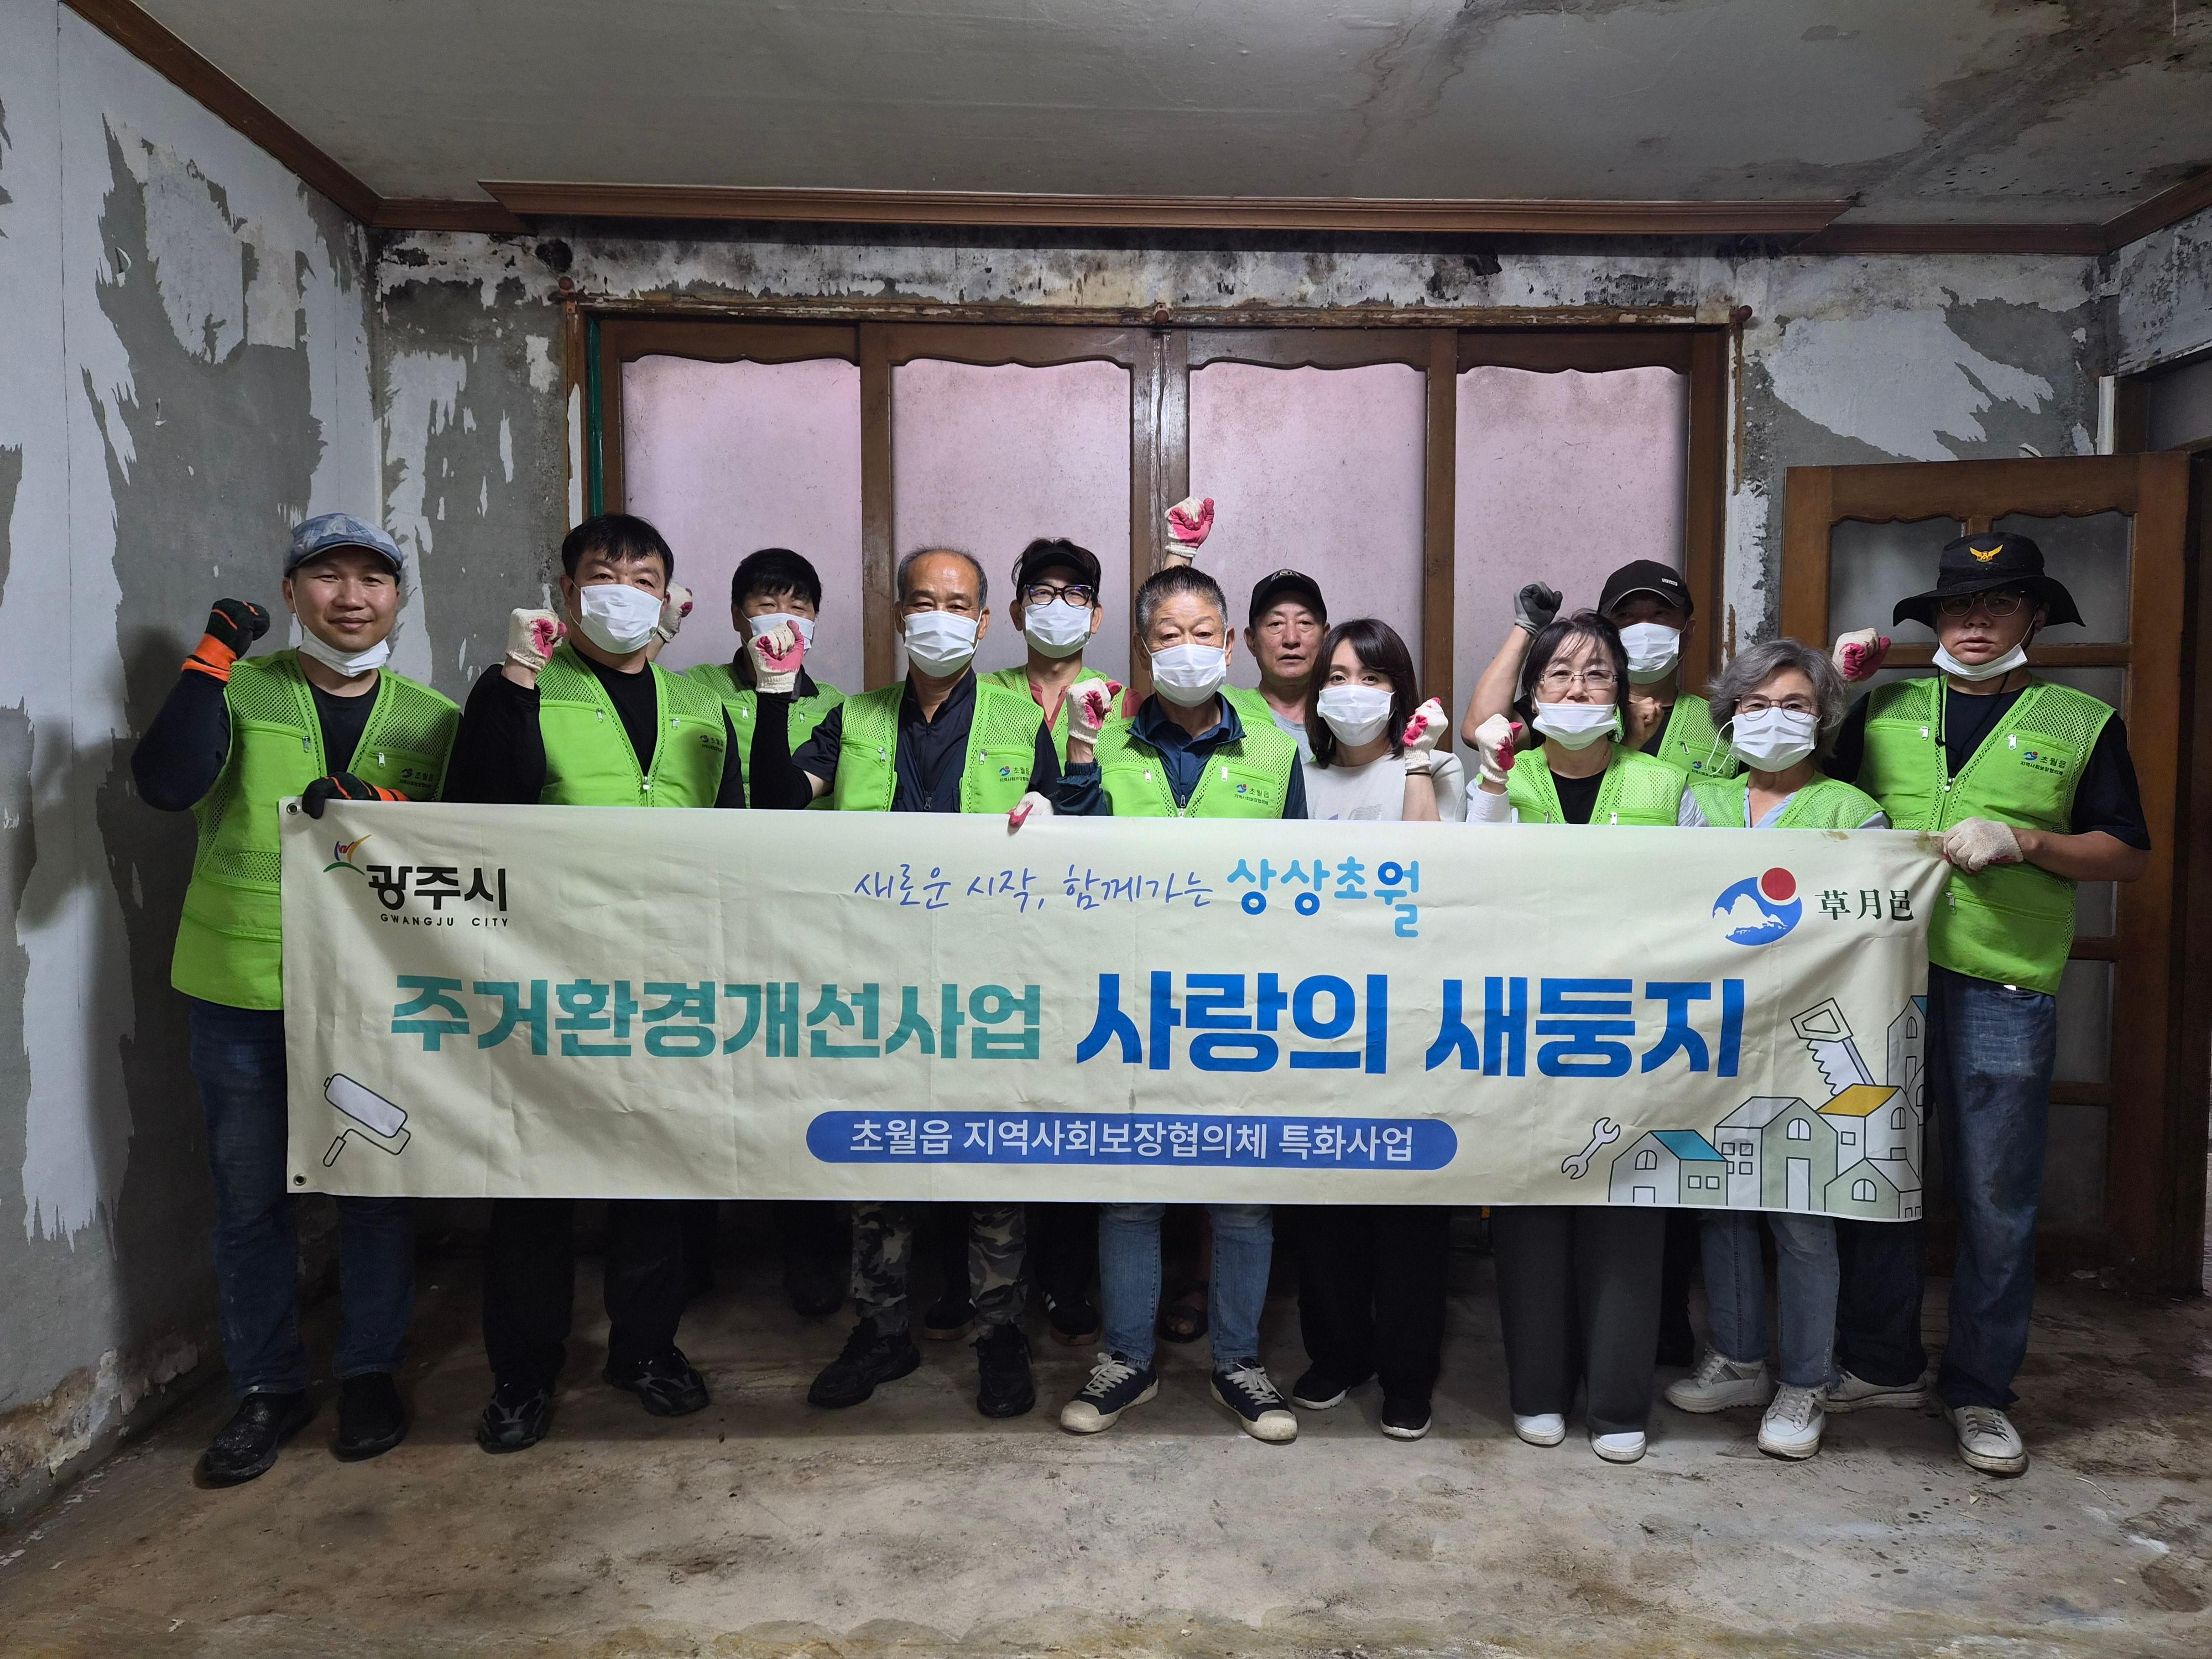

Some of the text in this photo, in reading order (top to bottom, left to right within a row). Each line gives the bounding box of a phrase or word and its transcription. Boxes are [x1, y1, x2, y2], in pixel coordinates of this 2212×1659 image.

[2020, 761, 2063, 776] 지역사회보장협의체
[2039, 756, 2067, 769] 초월읍
[1249, 788, 1270, 799] 초월읍
[366, 865, 507, 912] 광주시
[854, 856, 1419, 938] 새로운 시작, 함께가는 상상초월
[380, 913, 508, 927] GWANGJU CITY
[1815, 889, 1914, 921] 草月邑
[391, 971, 1745, 1078] 주거환경개선사업 사랑의 새둥지
[850, 1119, 1412, 1161] 초월읍 지역사회보장협의체 특화사업
